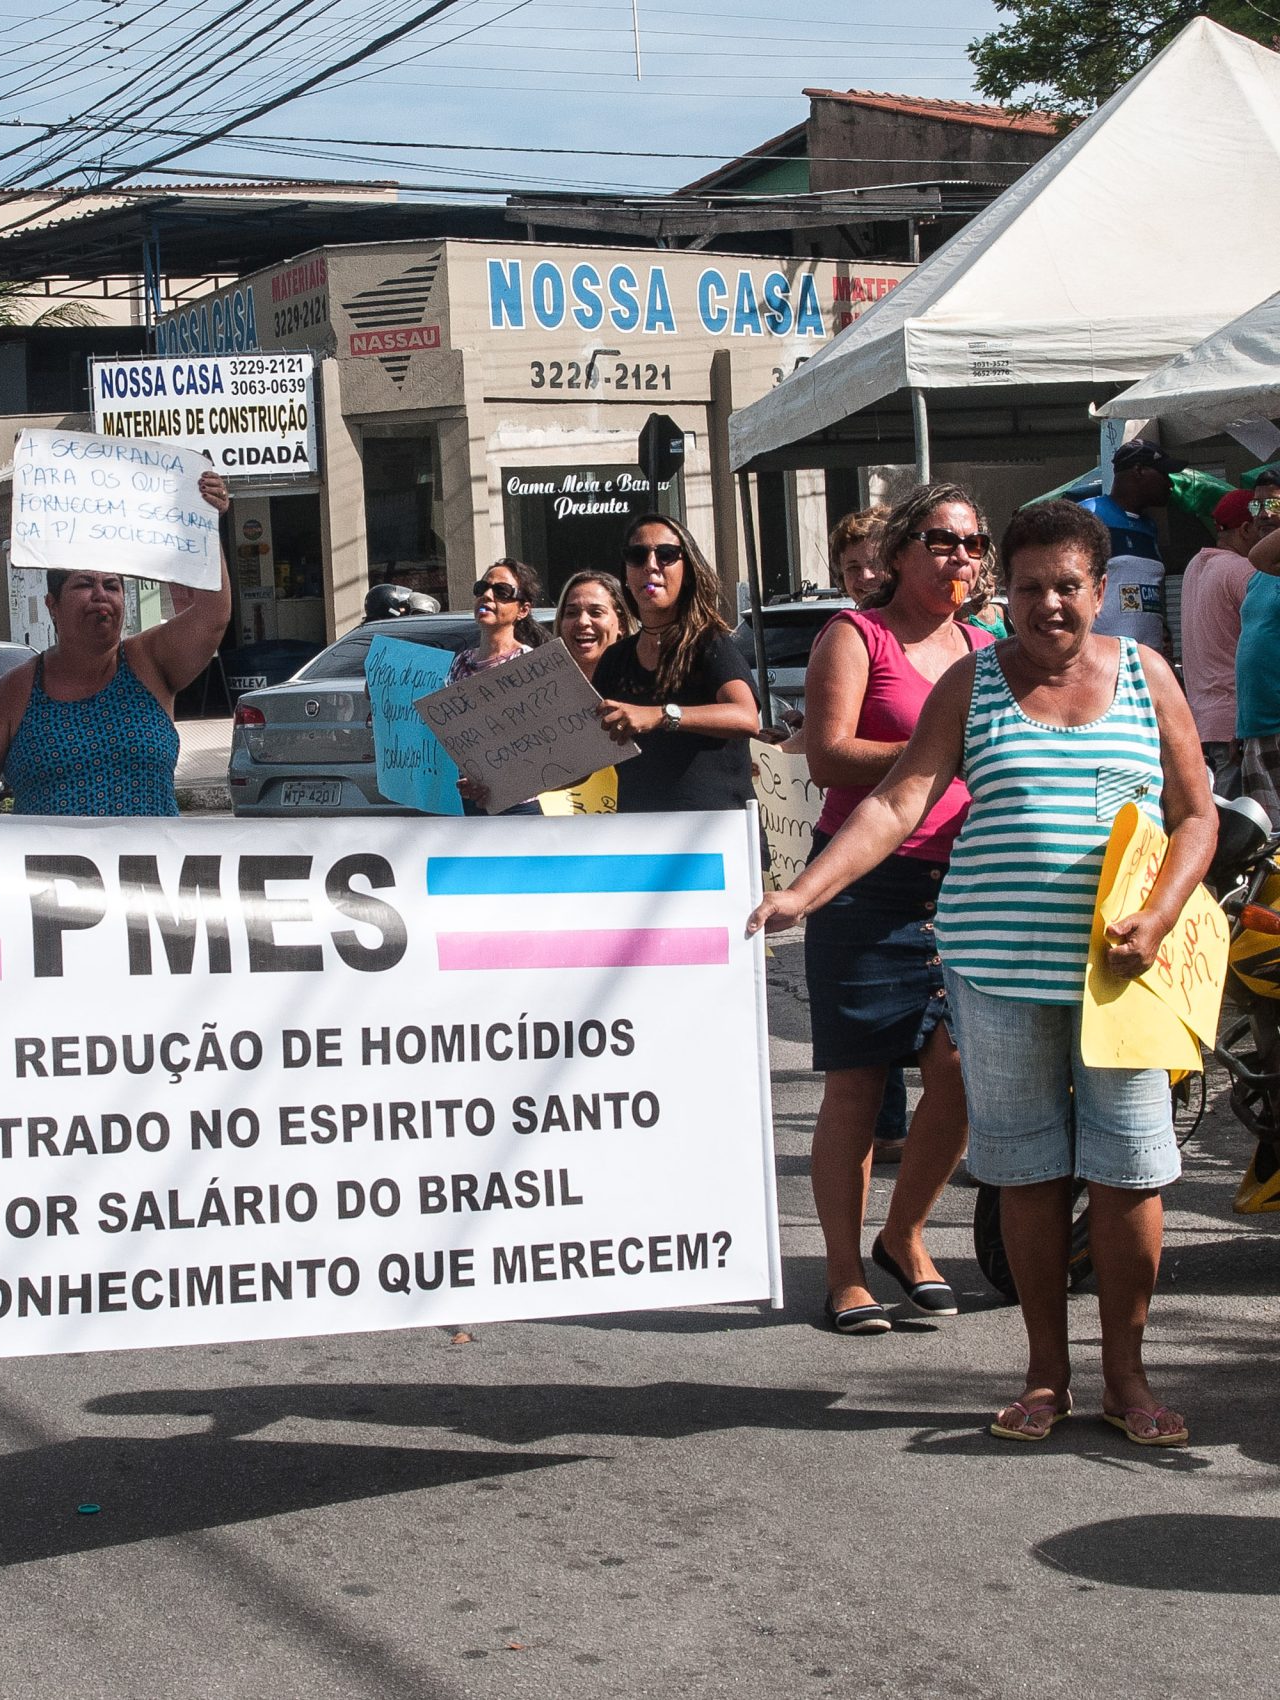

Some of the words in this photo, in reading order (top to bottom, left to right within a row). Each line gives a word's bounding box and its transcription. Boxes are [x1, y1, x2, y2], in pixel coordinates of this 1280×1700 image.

[271, 257, 327, 303] MATERIAIS
[486, 258, 678, 334] NOSSA
[697, 267, 827, 338] CASA
[212, 285, 258, 352] CASA
[274, 294, 327, 338] 3229-2121
[352, 328, 437, 352] NASSAU
[101, 366, 167, 399] NOSSA
[172, 364, 224, 396] CASA
[229, 358, 304, 376] 3229-2121
[231, 378, 306, 396] 3063-0639
[103, 408, 181, 437] MATERIAIS
[186, 408, 205, 435] DE
[209, 398, 308, 439] CONSTRUÇÃO
[52, 439, 184, 474] SEGURANÇA
[222, 442, 308, 466] CIDADÃ
[19, 464, 77, 485] PARA
[91, 469, 120, 489] OS
[132, 471, 179, 494] QUE
[507, 476, 556, 496] Cama
[558, 474, 600, 494] Mesa
[604, 480, 613, 493] e
[19, 492, 126, 518] FORNECEM
[554, 496, 630, 519] Presentes
[15, 521, 41, 543] ÇA
[51, 518, 76, 543] P/
[229, 678, 264, 688] RTLEV
[428, 687, 476, 726] CADÊ
[480, 684, 494, 702] A
[497, 652, 568, 694] MELHORIA
[445, 728, 484, 755] PARA
[490, 716, 504, 735] A
[463, 760, 484, 782] O
[485, 725, 557, 768] GOVERNO
[559, 706, 601, 734] COME
[760, 753, 786, 800] Se
[24, 853, 409, 978] PMES
[16, 1023, 263, 1084] REDUÇÃO
[282, 1029, 343, 1070] DE
[362, 1012, 635, 1066] HOMICÍDIOS
[191, 1108, 260, 1151] NO
[280, 1097, 495, 1147] ESPIRITO
[512, 1090, 661, 1135] SANTO
[98, 1178, 318, 1234] SALÁRIO
[337, 1177, 401, 1219] DO
[419, 1168, 583, 1215] BRASIL
[378, 1248, 475, 1295] QUE
[493, 1231, 733, 1286] MERECEM?
